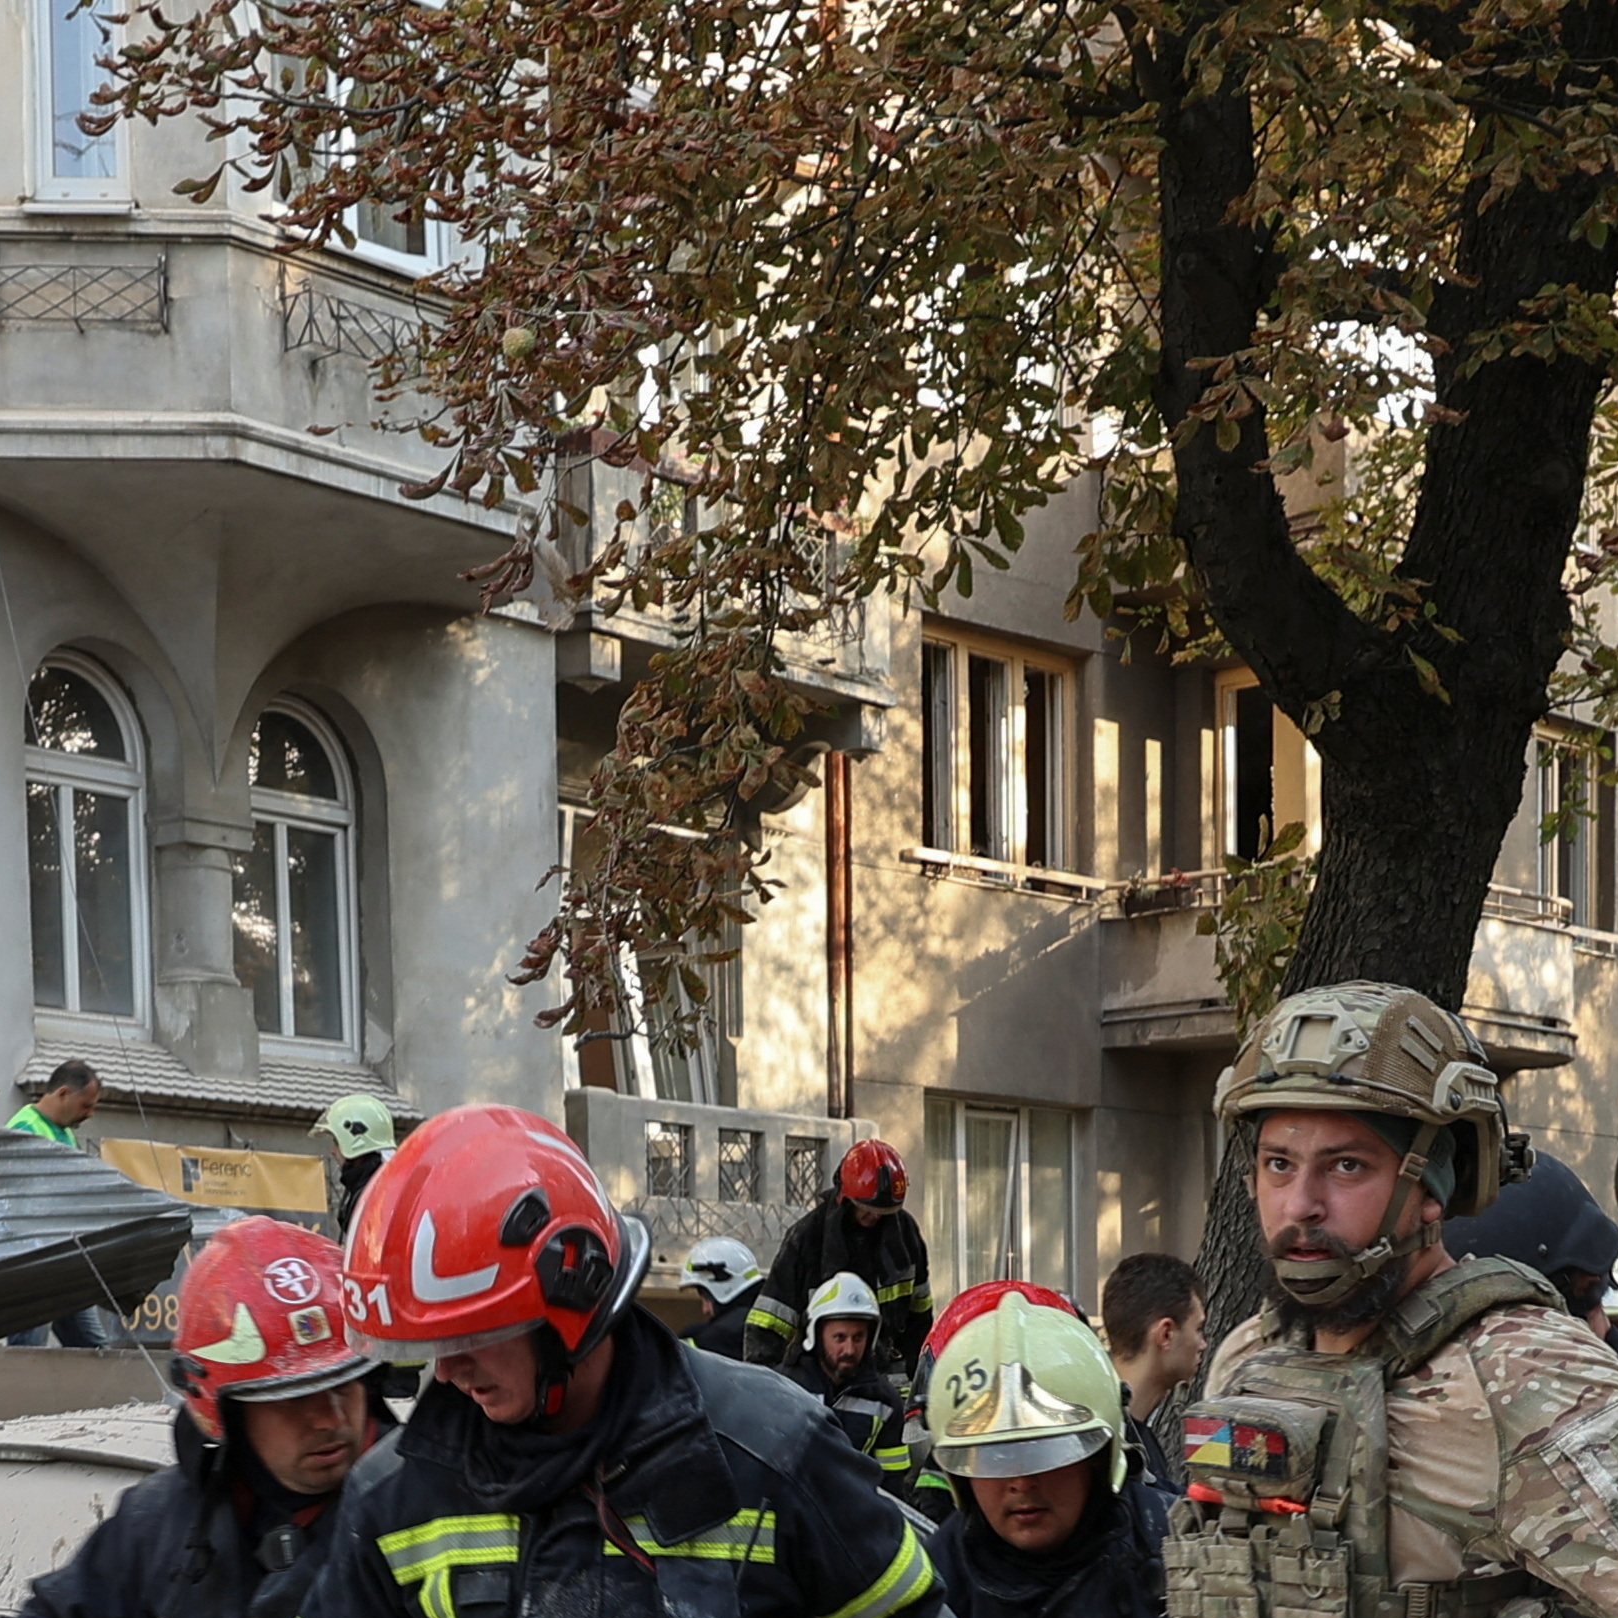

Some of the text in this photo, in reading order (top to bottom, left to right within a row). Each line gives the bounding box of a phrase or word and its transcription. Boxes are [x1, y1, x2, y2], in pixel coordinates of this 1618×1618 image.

[201, 1157, 253, 1178] Ferenc
[344, 1278, 394, 1326] 31
[945, 1357, 988, 1409] 25
